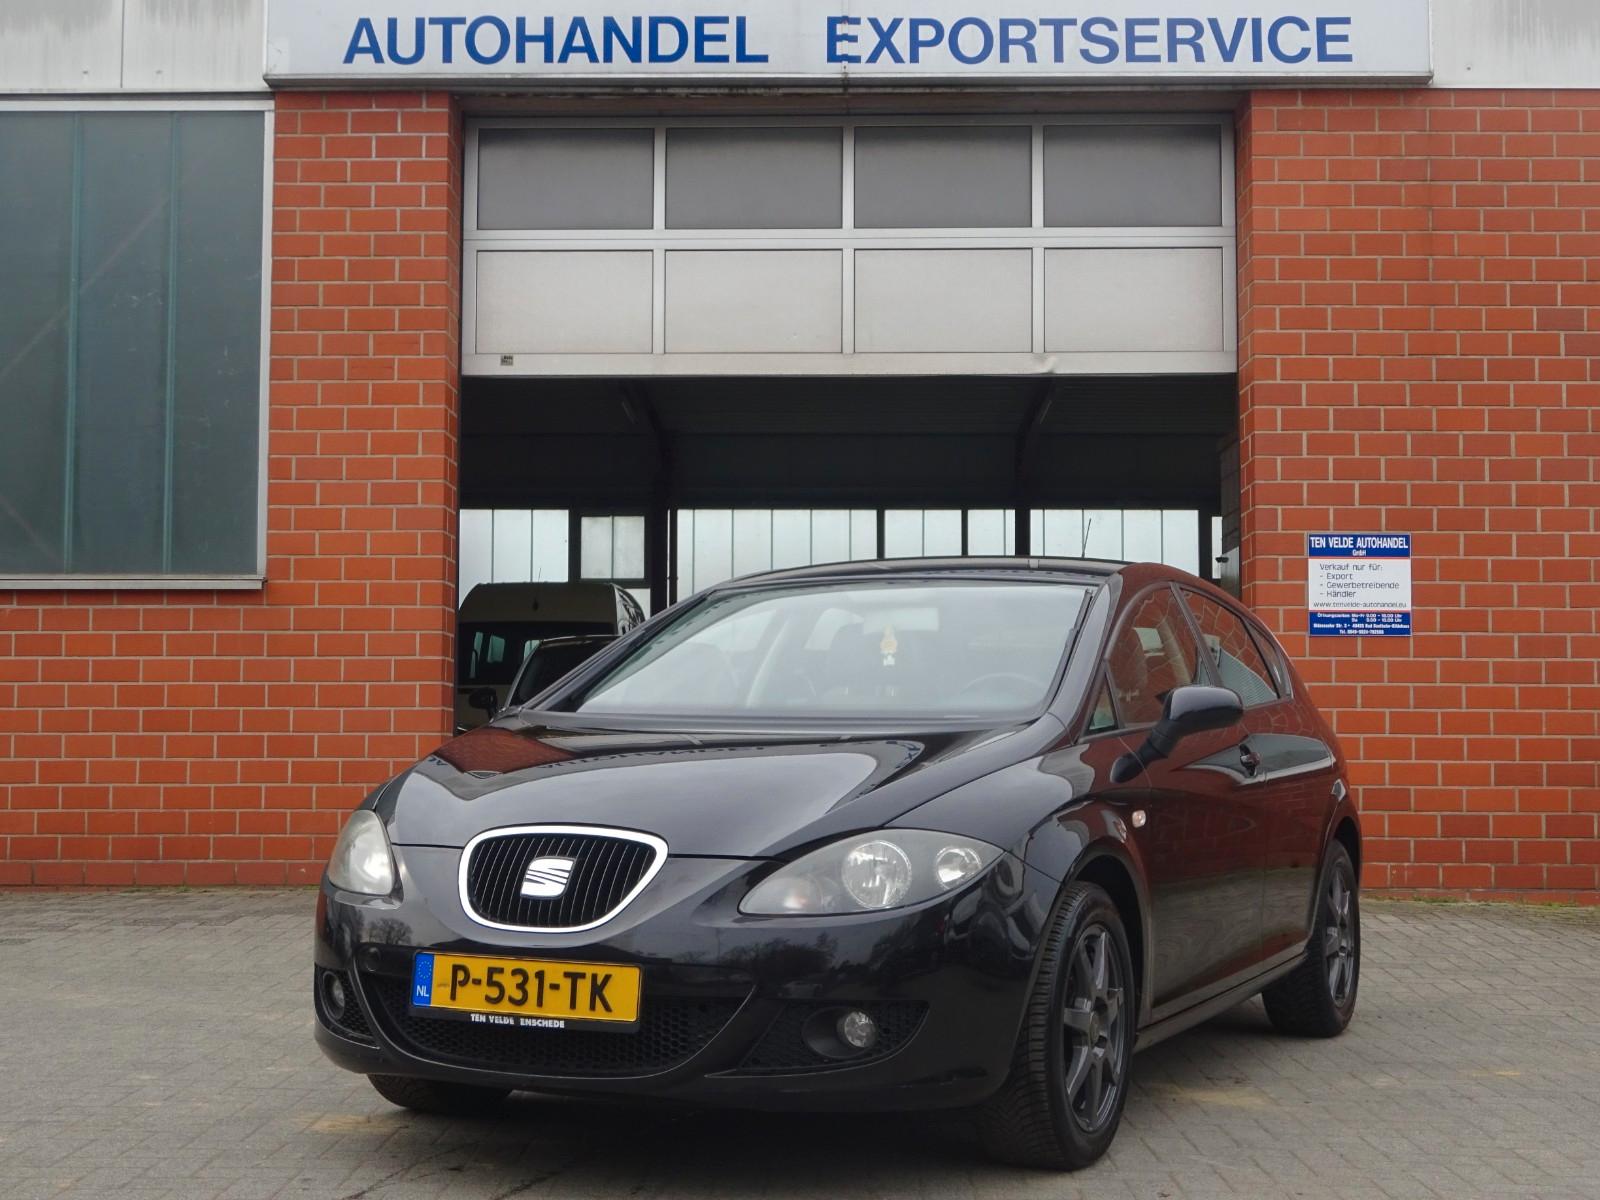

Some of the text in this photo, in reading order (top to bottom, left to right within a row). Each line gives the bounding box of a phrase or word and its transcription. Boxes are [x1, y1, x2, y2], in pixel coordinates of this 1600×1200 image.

[343, 15, 1353, 65] AUTOHANDEL EXPORTSERVICE
[1310, 537, 1408, 548] TEN VELDE AUTOHANDEL
[1319, 563, 1349, 571] Verkauf
[1326, 572, 1353, 580] Export
[1326, 581, 1400, 589] Gewerbetreibende
[1326, 590, 1356, 598] Händler
[416, 985, 429, 997] NL
[450, 964, 612, 1012] P-531-TK
[470, 1013, 565, 1028] TEN VELDE ENSCHEDE
